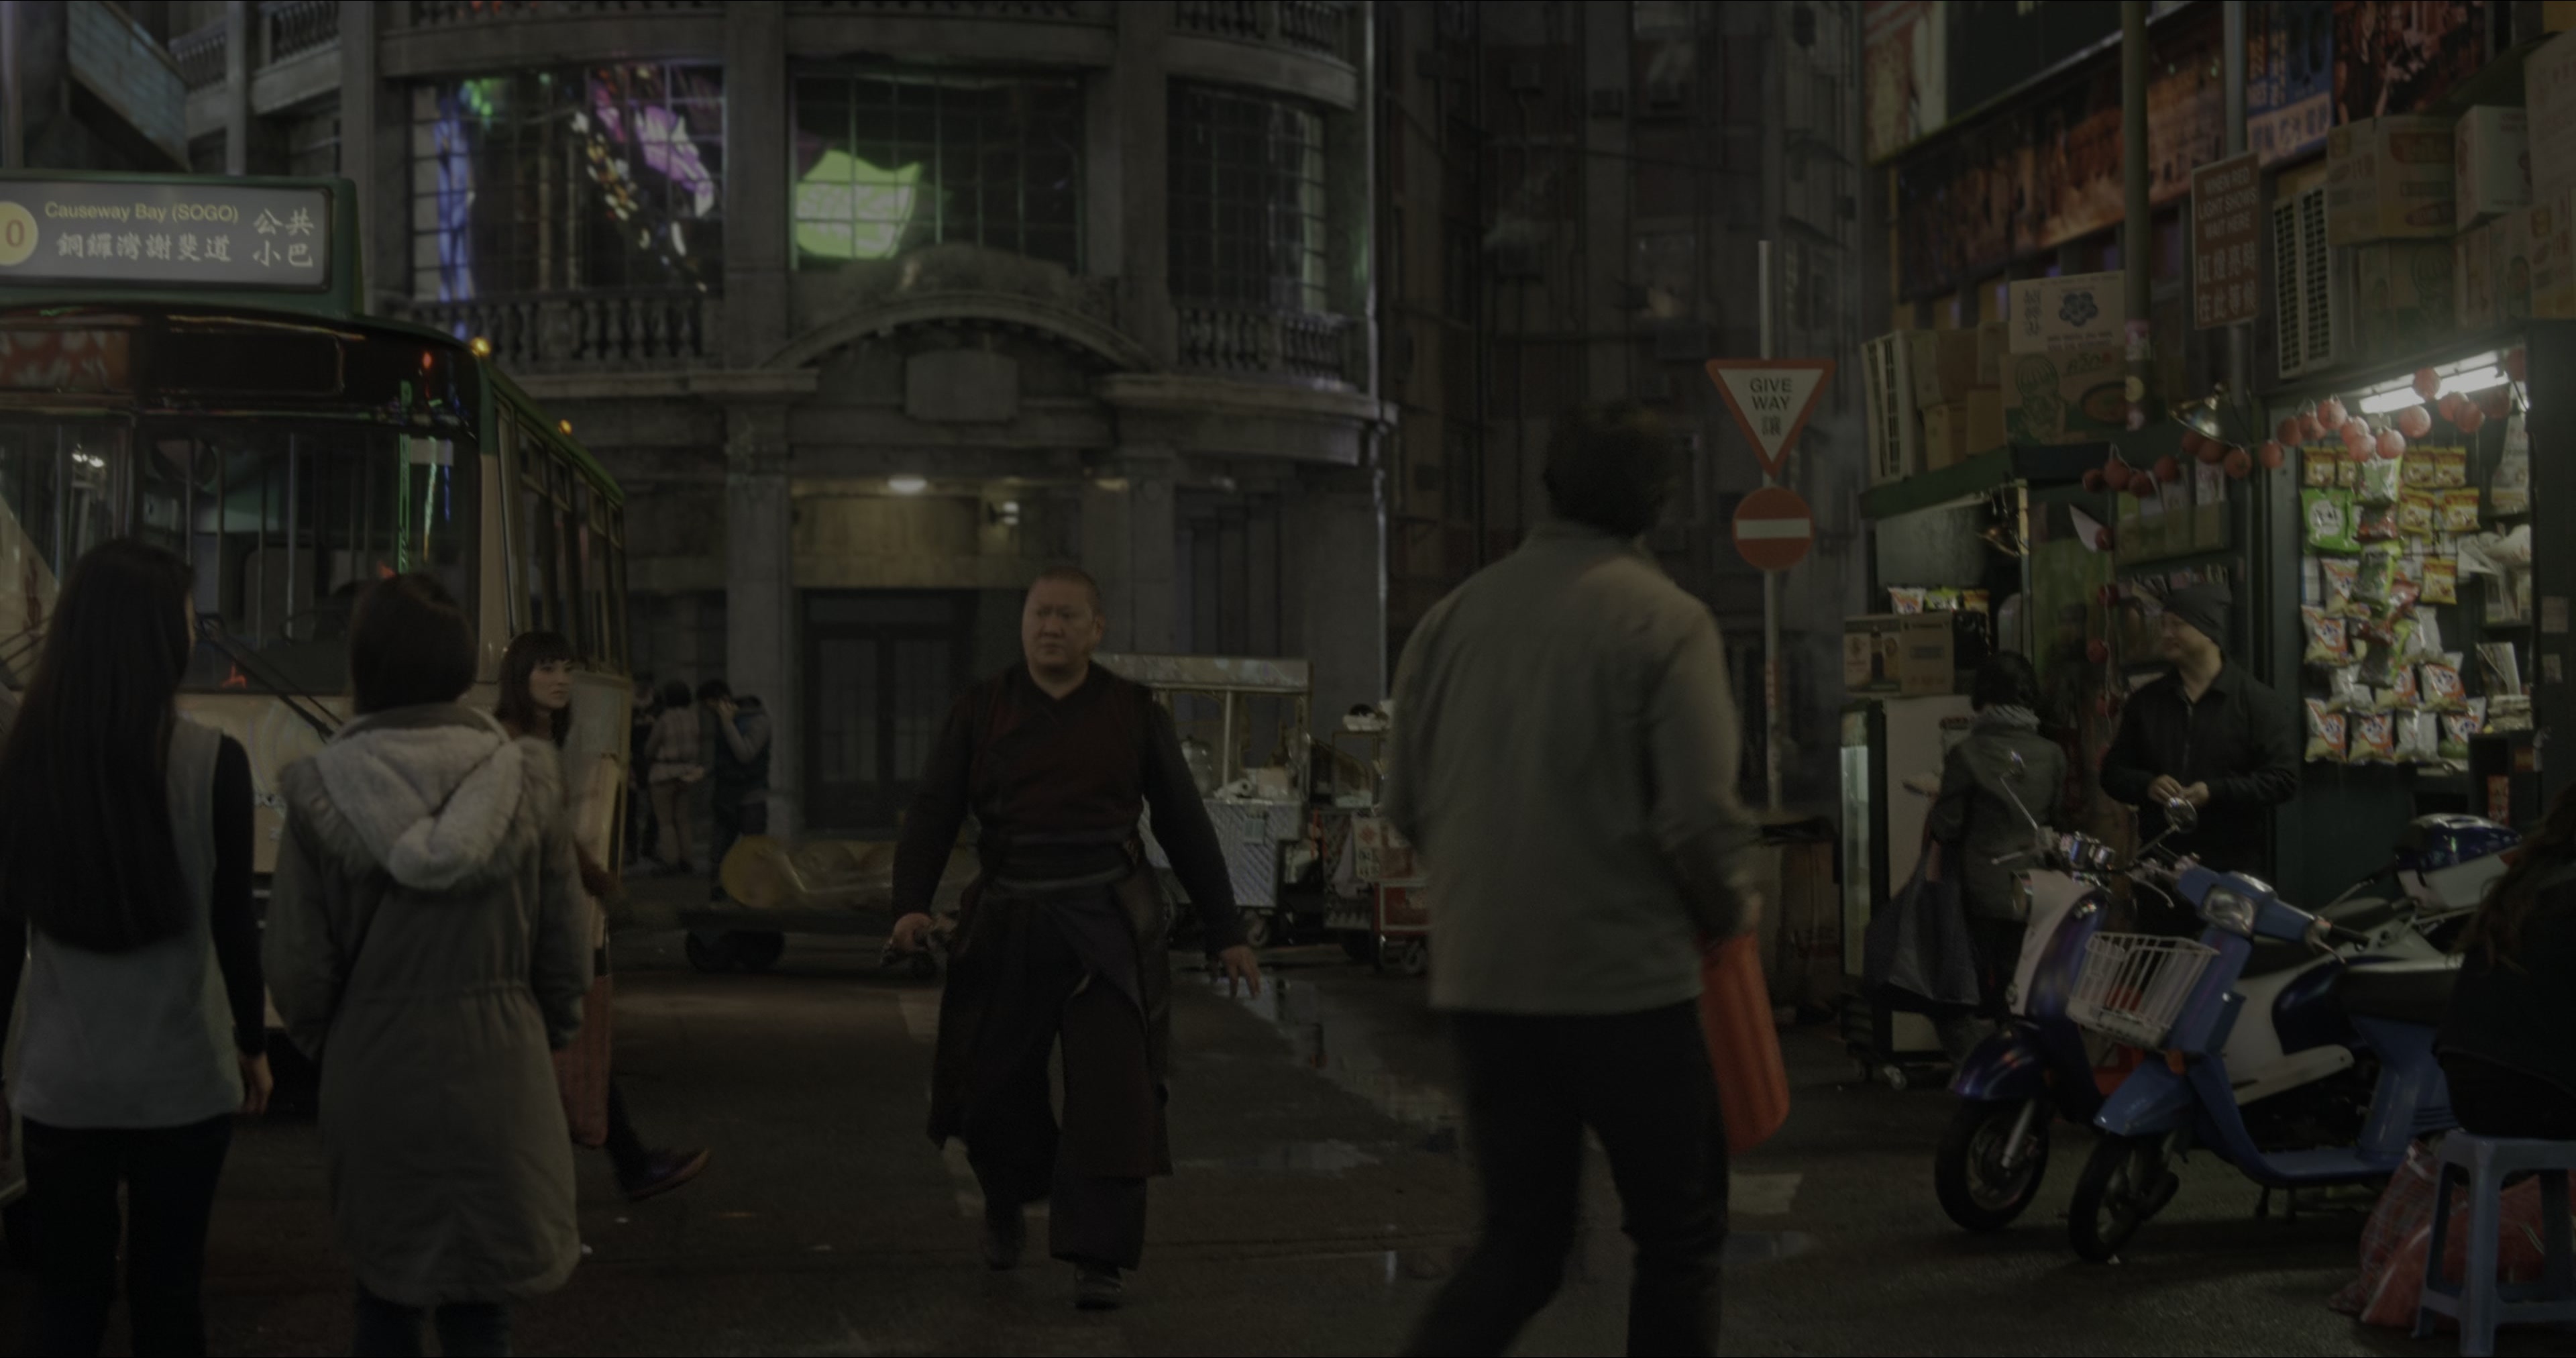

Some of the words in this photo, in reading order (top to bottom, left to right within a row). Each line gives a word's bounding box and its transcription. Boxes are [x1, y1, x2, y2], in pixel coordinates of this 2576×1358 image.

[2204, 175, 2230, 195] WHEN
[2232, 166, 2251, 186] RED
[45, 202, 128, 222] Causeway
[136, 203, 167, 222] Bay
[172, 203, 239, 223] (SOGO)
[2199, 198, 2223, 220] LIGHT
[2224, 186, 2257, 213] SHOWS
[253, 207, 315, 236] 公共
[2205, 219, 2226, 239] WAIT
[2227, 211, 2252, 233] HERE
[252, 240, 315, 268] 小巴
[1750, 378, 1792, 392] GIVE
[1752, 396, 1789, 410] WAY
